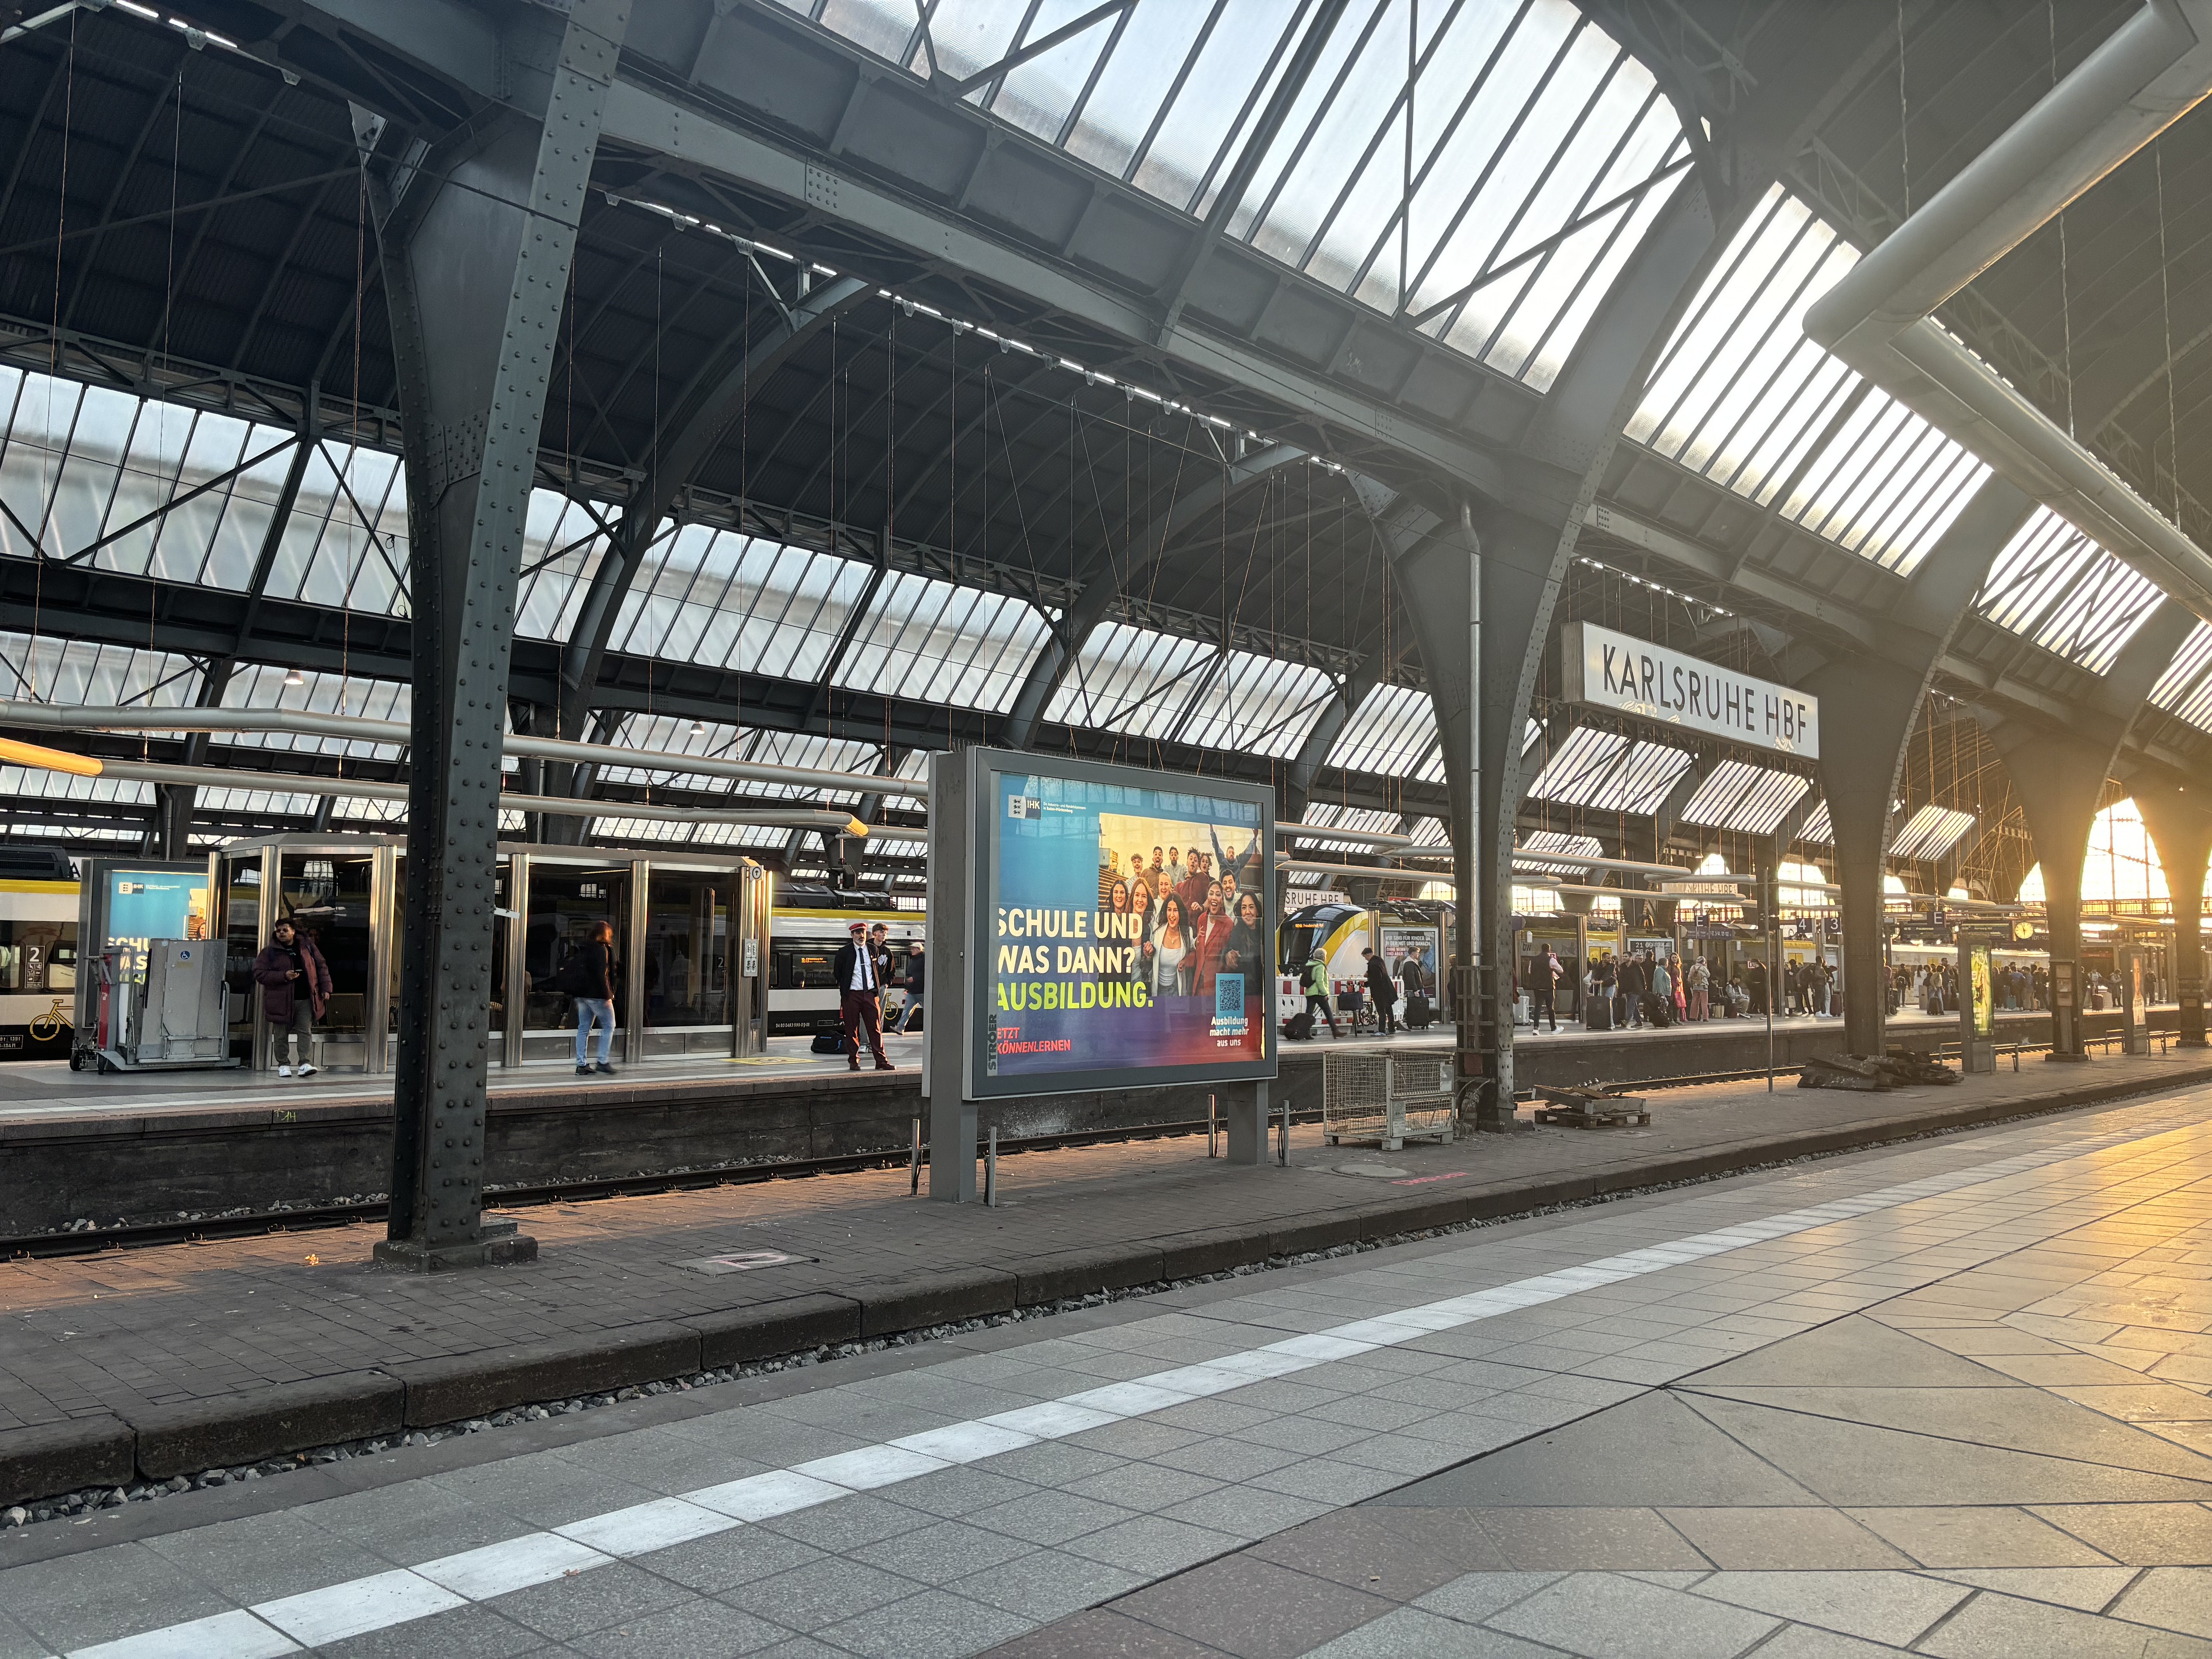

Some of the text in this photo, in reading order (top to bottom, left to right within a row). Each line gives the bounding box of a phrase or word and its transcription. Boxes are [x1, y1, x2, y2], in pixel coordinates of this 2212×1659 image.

[1603, 643, 1806, 743] KARLSRUHE HBF
[1027, 800, 1040, 809] IHK
[1696, 915, 1704, 927] E
[1799, 918, 1806, 930] 4
[1831, 918, 1838, 929] 3
[1934, 912, 1942, 924] E
[1094, 911, 1143, 939] UND
[29, 947, 40, 962] 2
[998, 945, 1136, 974] WAS DANN?
[718, 957, 724, 968] 2
[998, 981, 1153, 1011] AUSBILDUNG.
[1211, 1016, 1248, 1027] Ausbildung
[1209, 1027, 1249, 1036] macht mehr
[988, 1014, 997, 1070] STRÖER
[997, 1039, 1072, 1054] KÖNNENLERNEN
